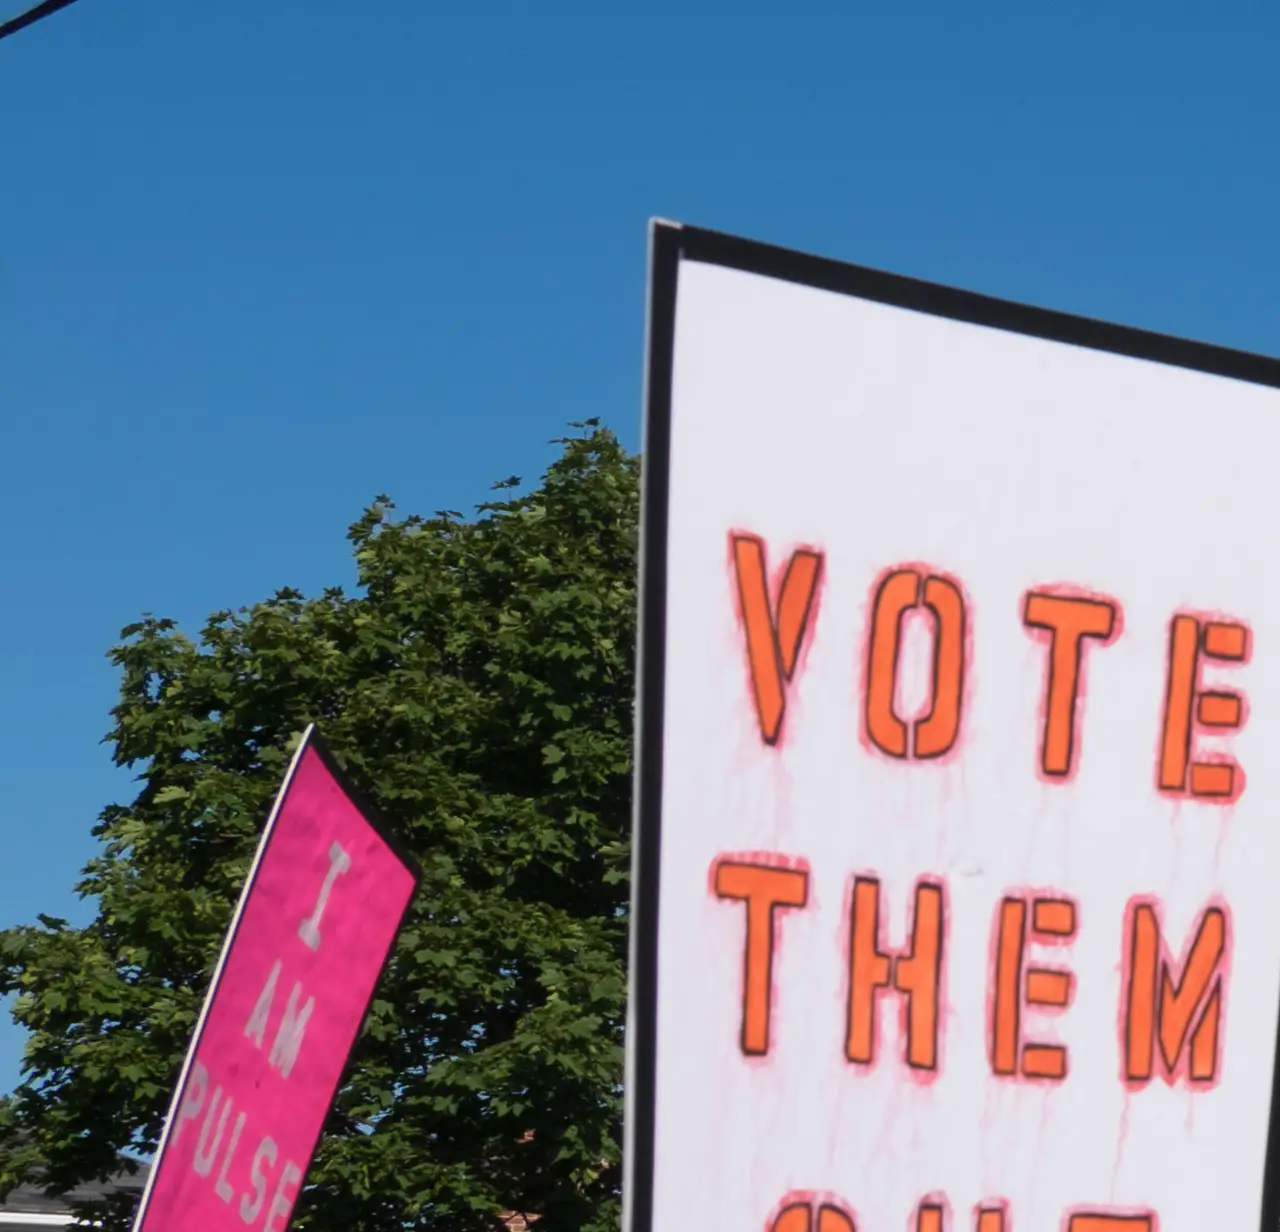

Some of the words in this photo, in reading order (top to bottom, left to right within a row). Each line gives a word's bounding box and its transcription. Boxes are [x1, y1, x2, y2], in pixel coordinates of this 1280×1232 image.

[728, 528, 1253, 803] VOTE
[298, 841, 350, 951] I
[709, 852, 1232, 1090] THEM
[243, 957, 315, 1080] AM
